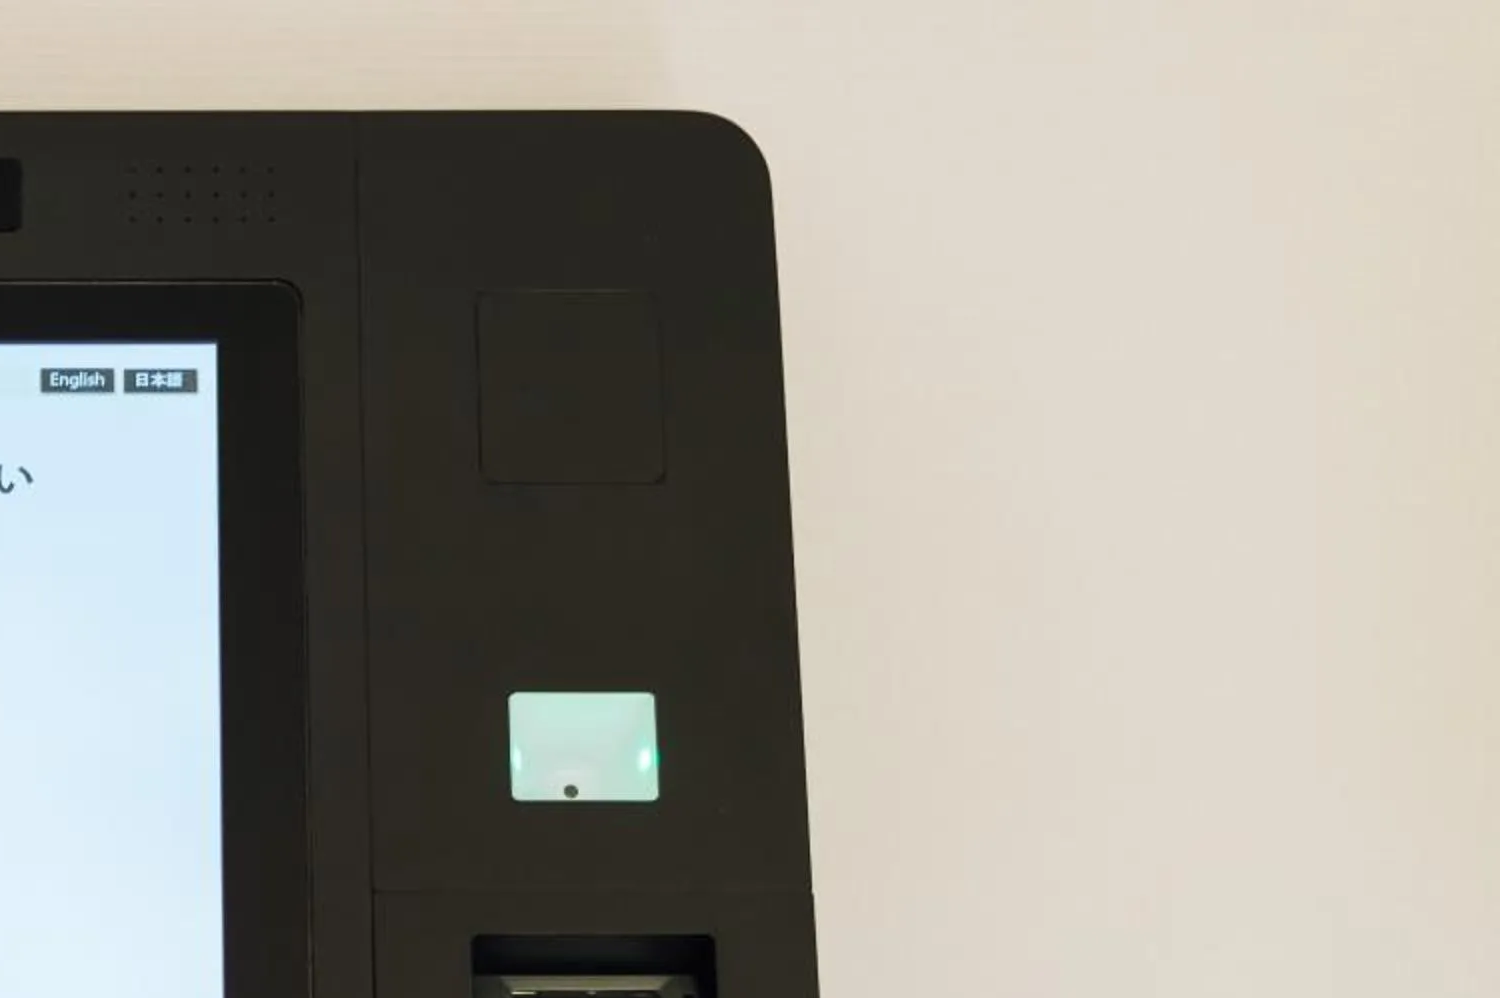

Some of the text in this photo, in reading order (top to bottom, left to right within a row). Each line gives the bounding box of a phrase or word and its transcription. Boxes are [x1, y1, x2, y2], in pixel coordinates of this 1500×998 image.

[50, 371, 105, 390] English
[135, 372, 183, 388] 日本語
